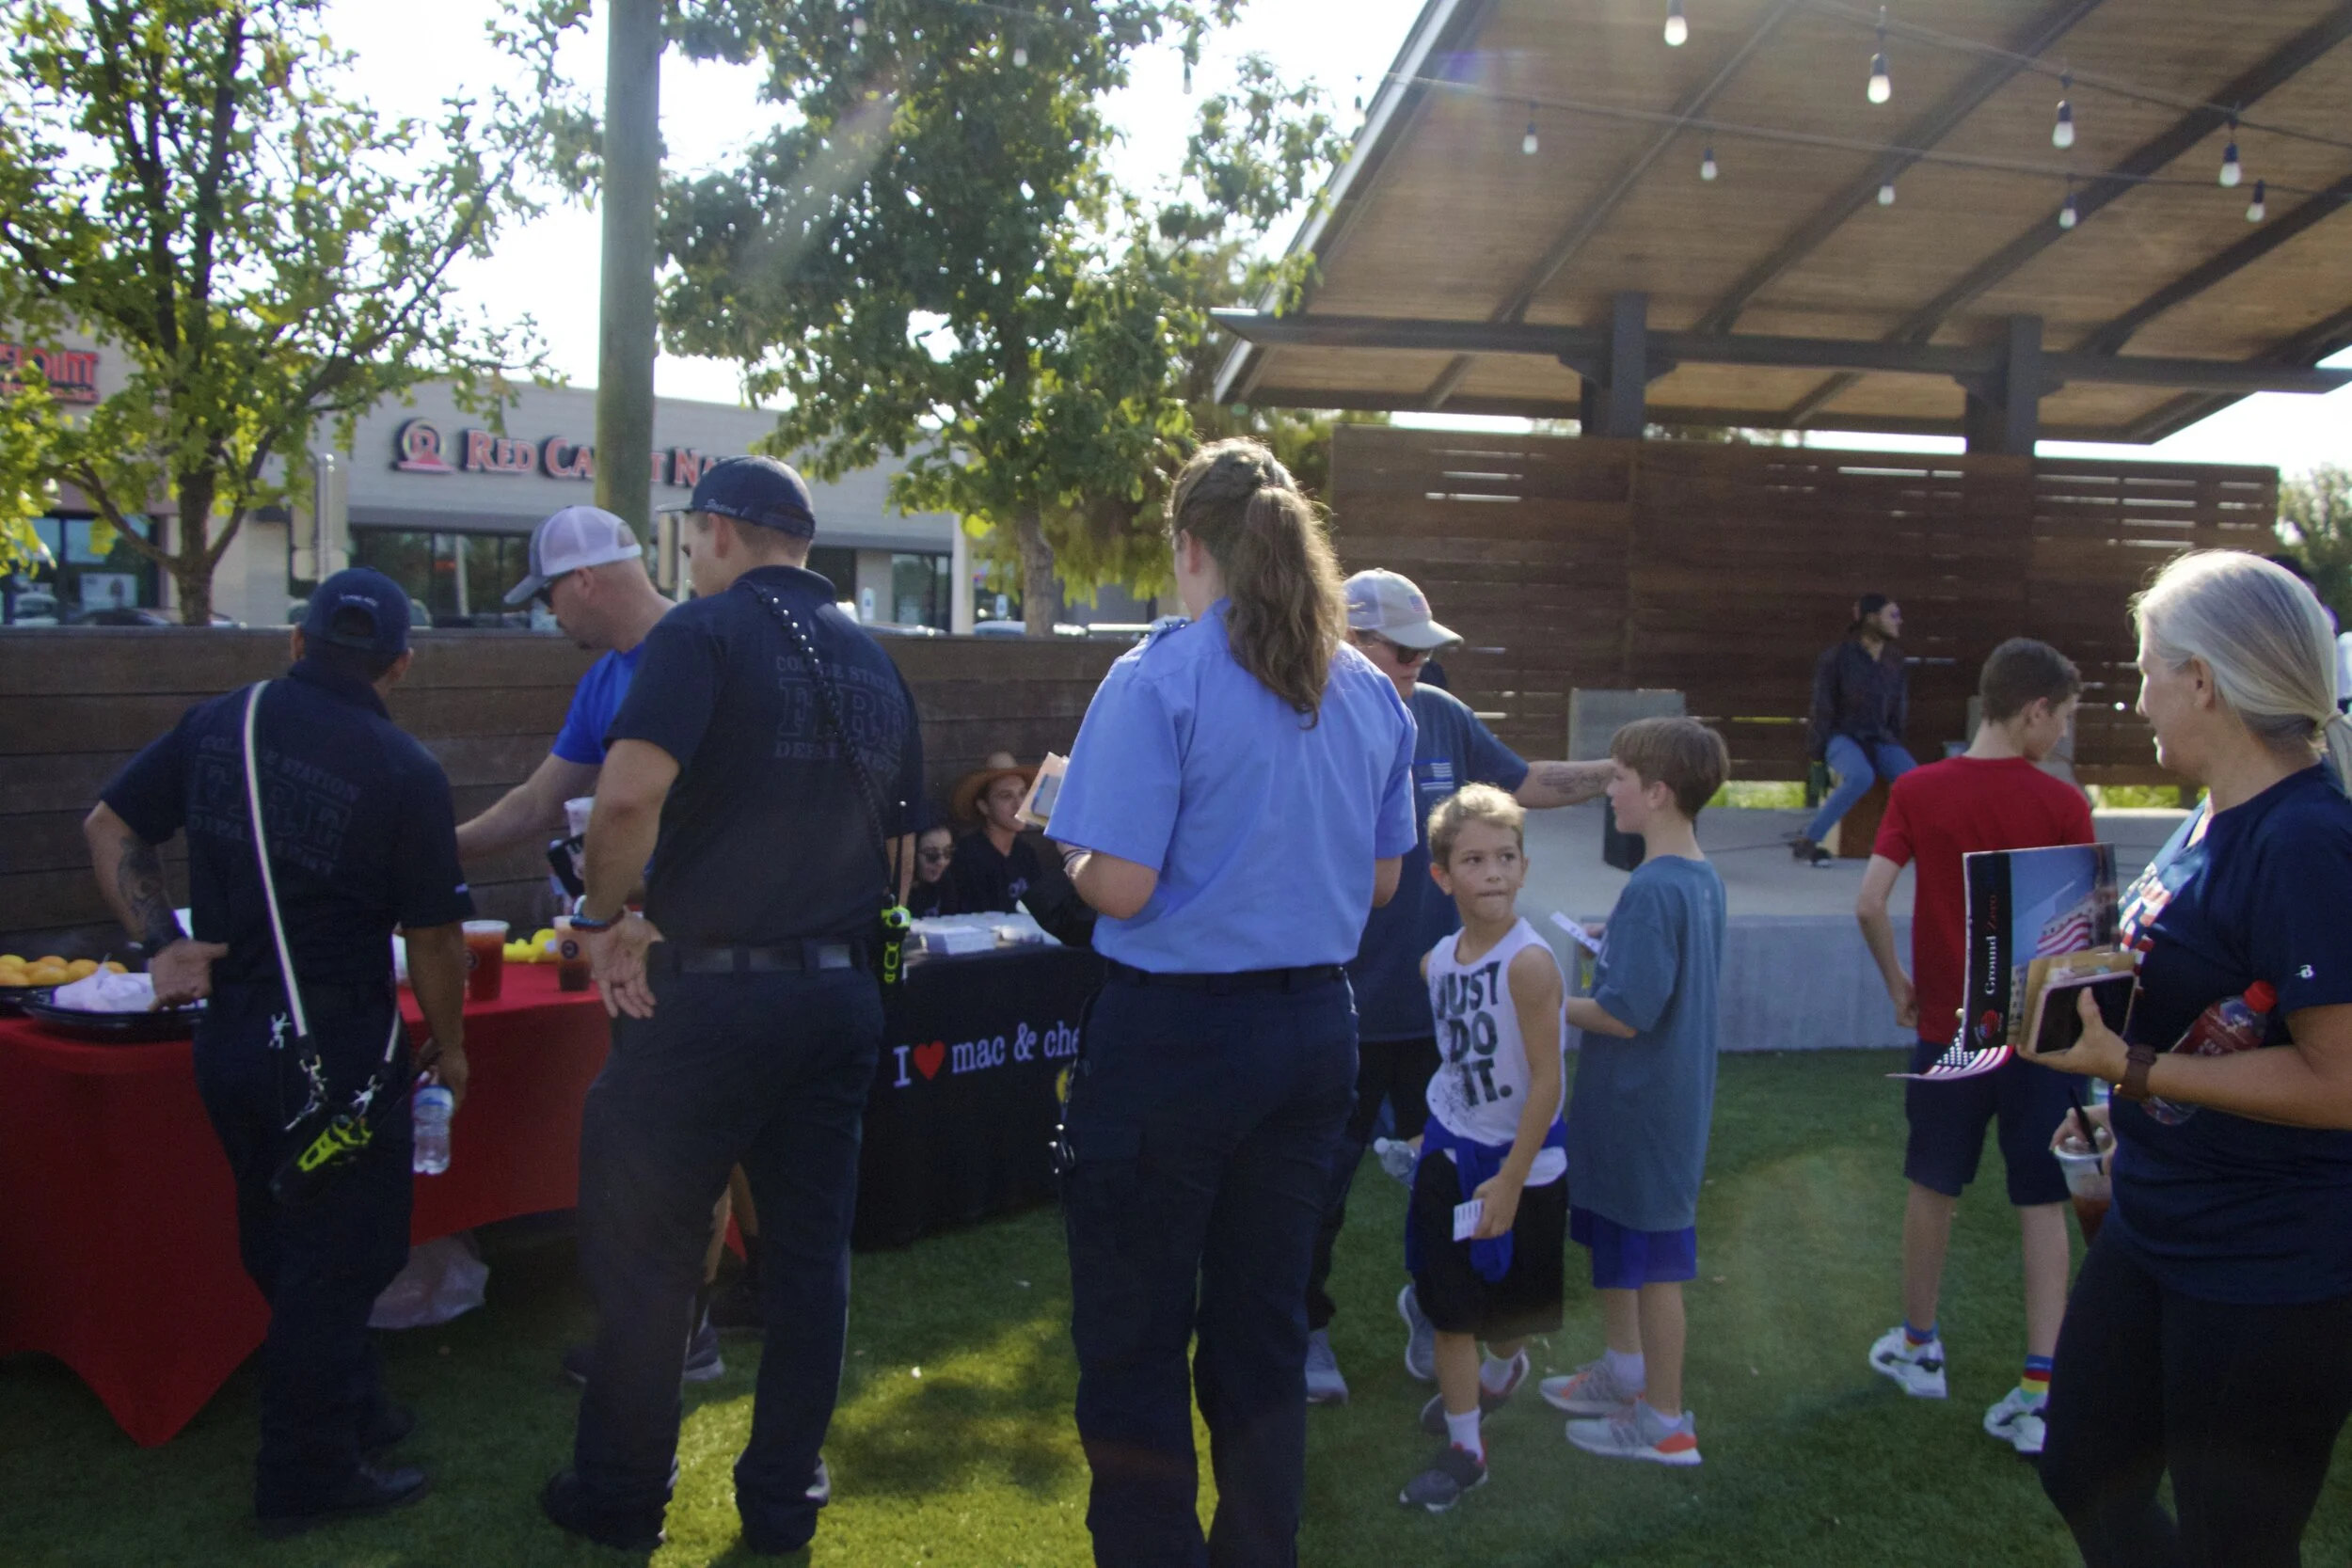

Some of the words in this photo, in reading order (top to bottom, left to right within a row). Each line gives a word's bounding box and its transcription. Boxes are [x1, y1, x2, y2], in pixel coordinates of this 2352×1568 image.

[466, 429, 537, 471] RED
[545, 436, 666, 483] CAT
[1987, 895, 1997, 930] Zero
[1436, 960, 1501, 1020] JUST
[1984, 935, 1997, 995] Ground
[893, 1046, 912, 1088] I
[951, 1036, 1007, 1074] mac
[1013, 1022, 1039, 1062] &
[1448, 1011, 1498, 1063] DO
[1460, 1057, 1513, 1106] IT.
